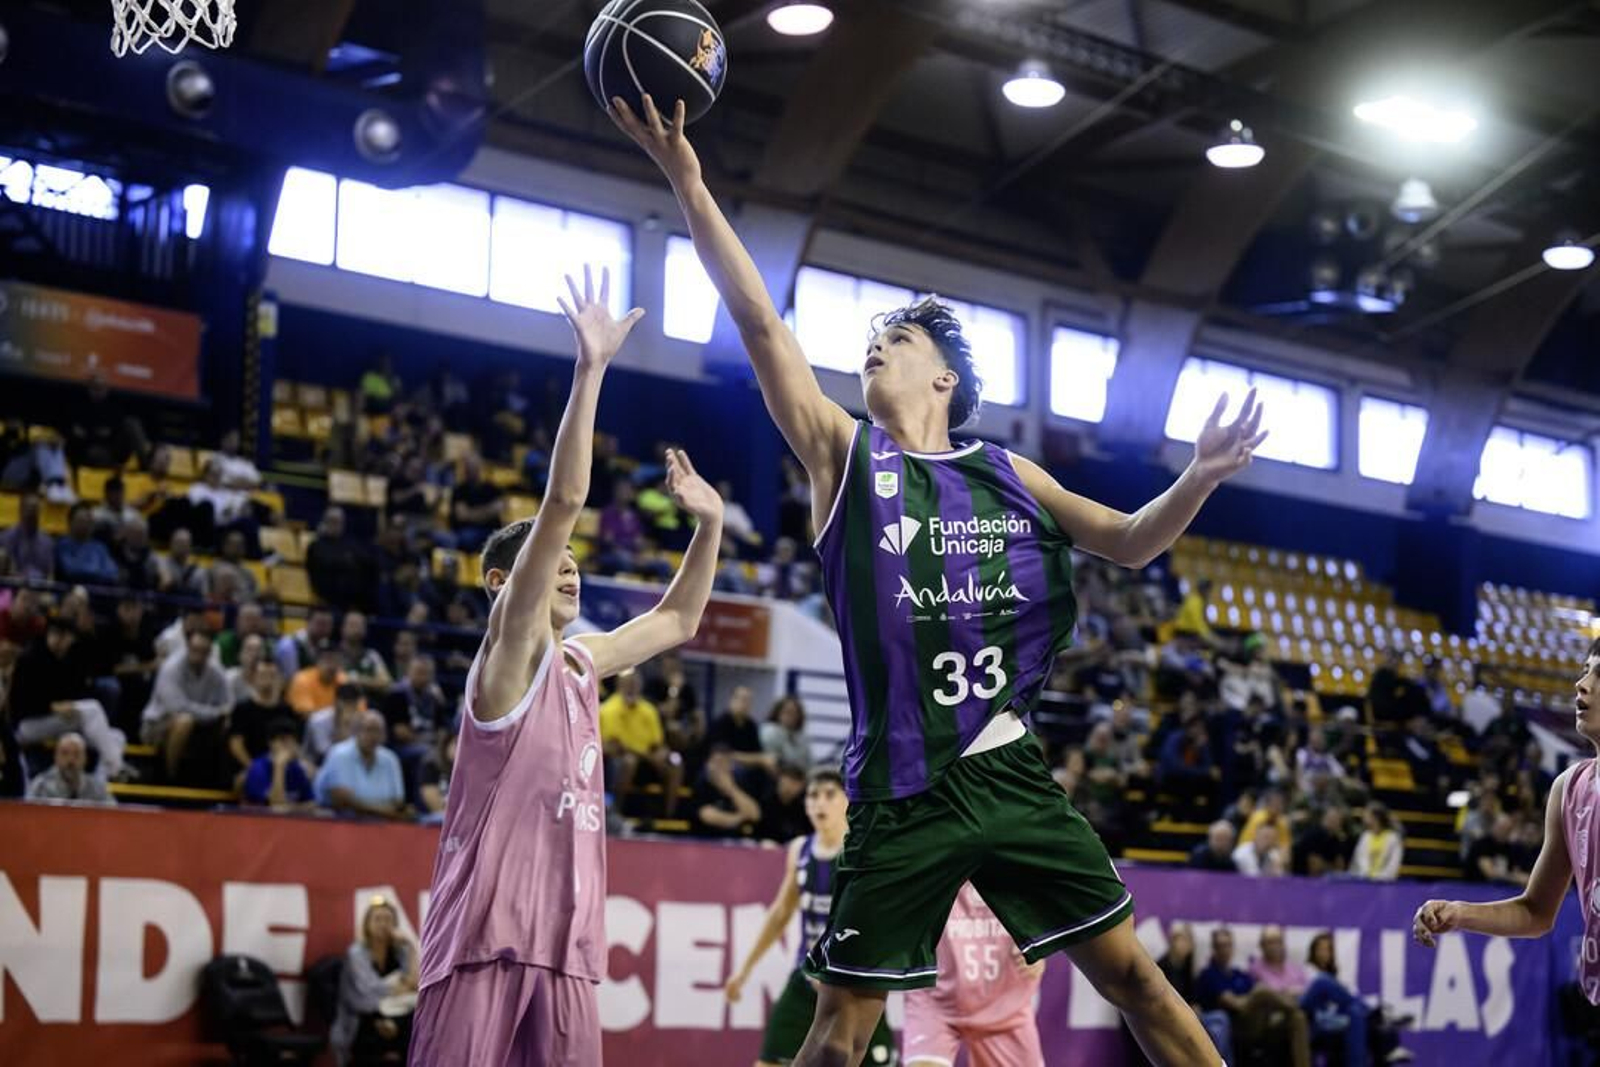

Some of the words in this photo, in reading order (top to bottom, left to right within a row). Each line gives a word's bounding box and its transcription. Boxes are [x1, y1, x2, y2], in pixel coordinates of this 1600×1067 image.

[928, 514, 1032, 536] Fundación
[930, 536, 1005, 559] Unicaja
[893, 570, 1031, 609] Andalucía
[932, 645, 1008, 706] 33
[963, 943, 1000, 982] 55
